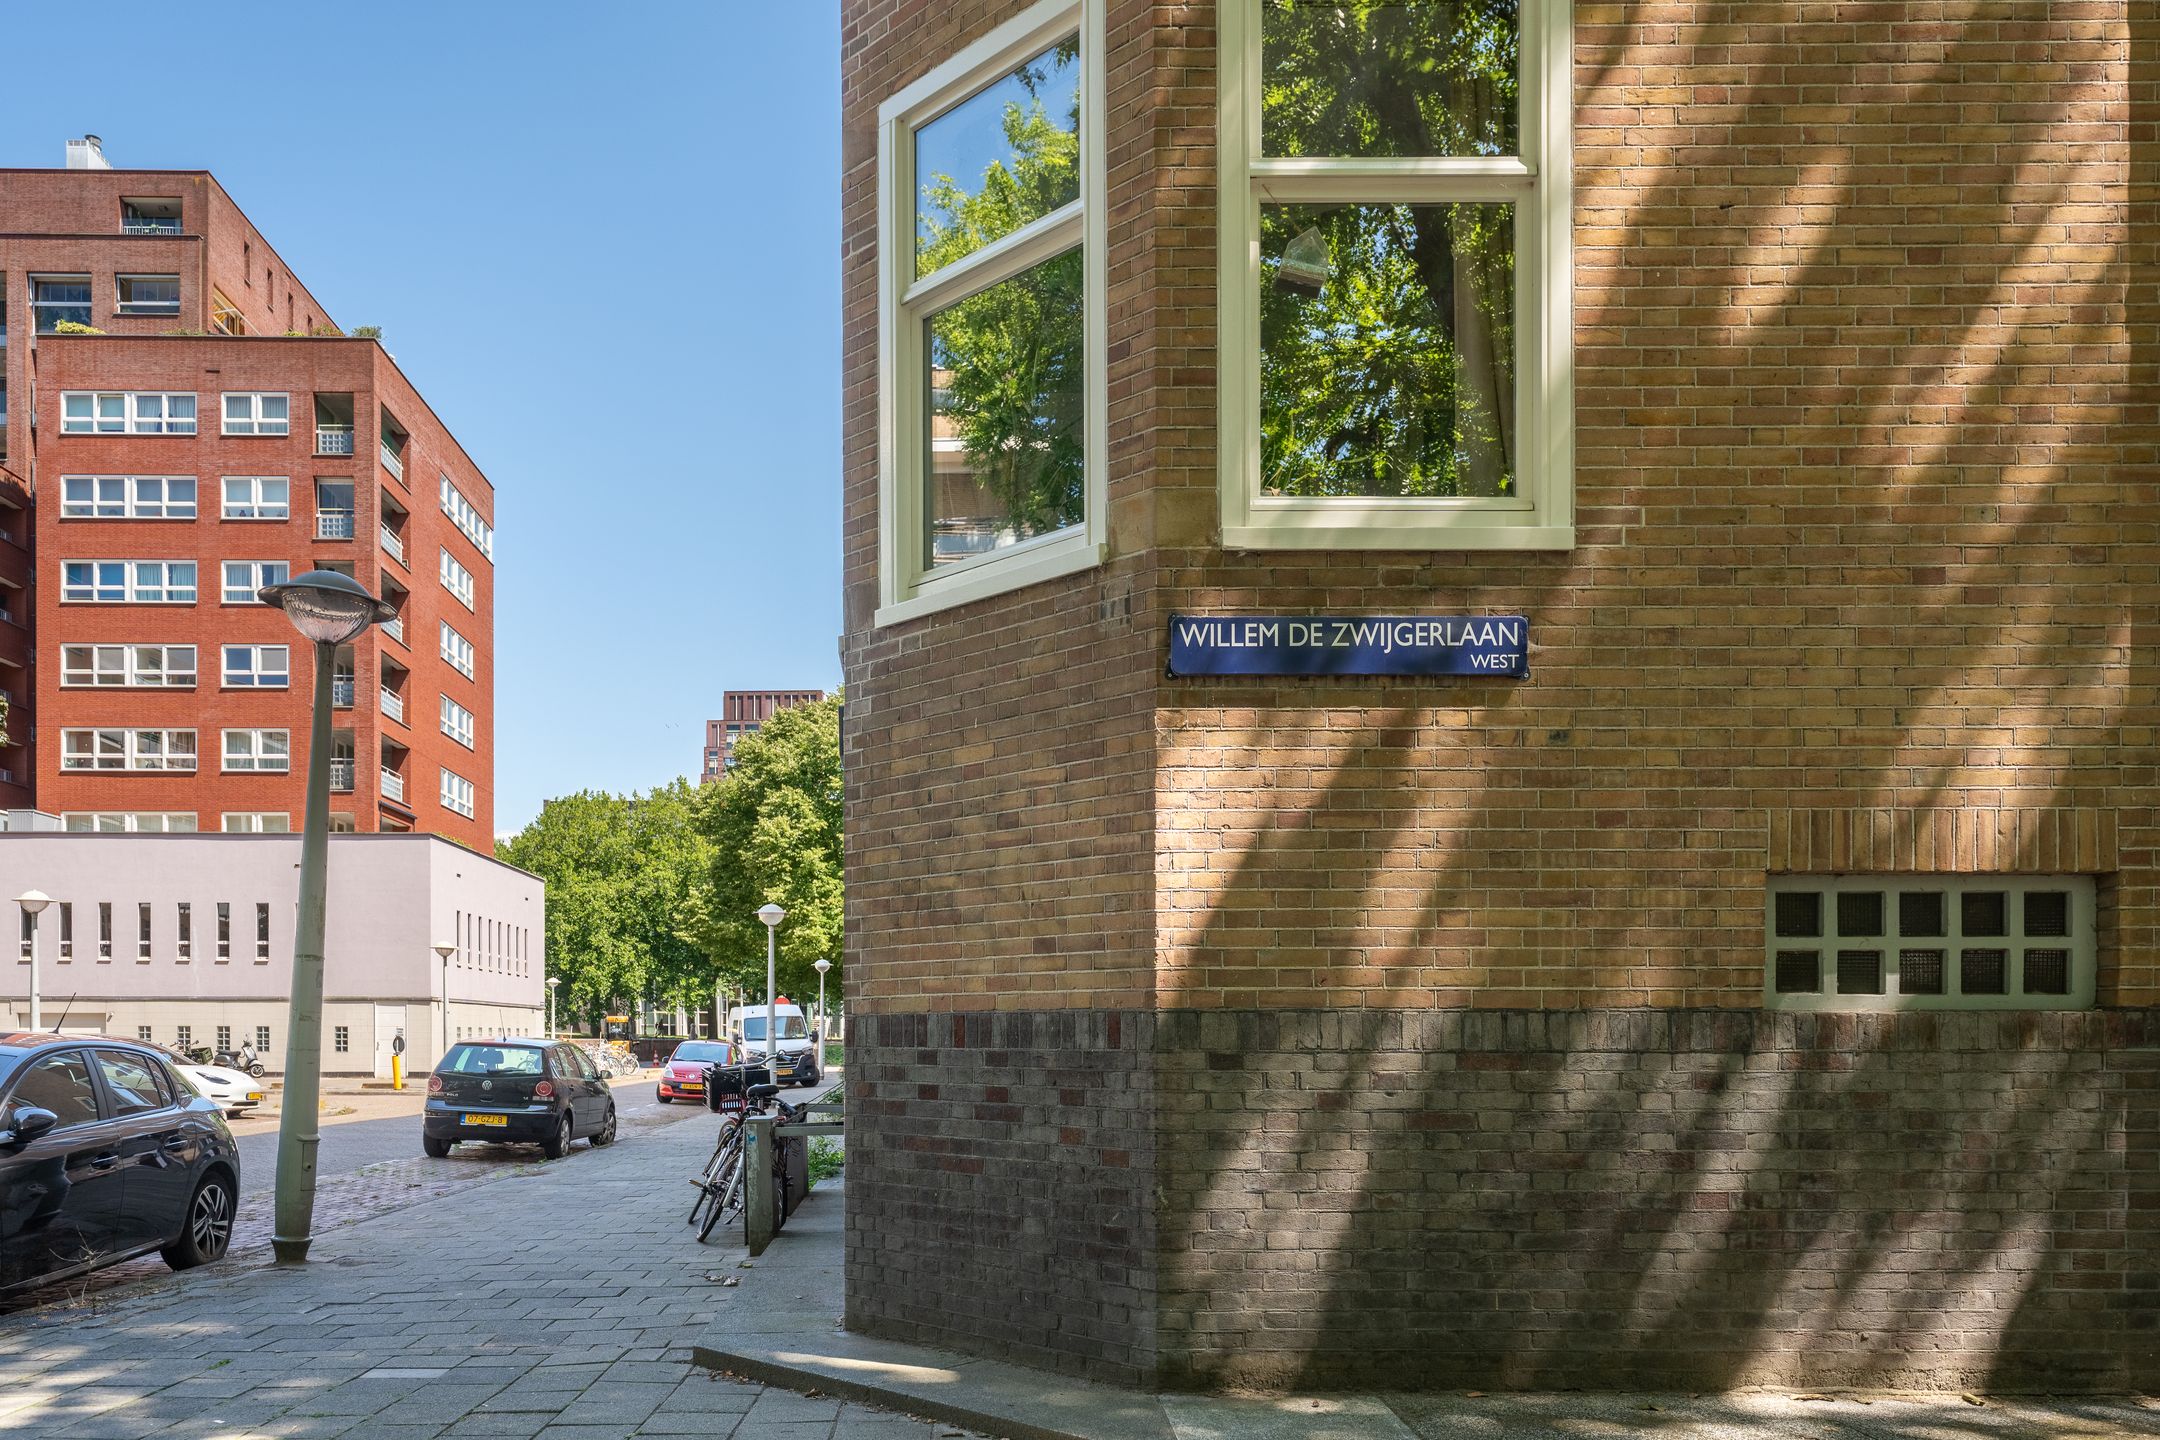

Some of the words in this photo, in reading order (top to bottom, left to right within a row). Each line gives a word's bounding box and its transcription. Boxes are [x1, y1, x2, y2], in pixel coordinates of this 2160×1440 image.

[1179, 623, 1279, 647] WILLEM
[1289, 623, 1323, 647] DE
[1331, 622, 1519, 654] ZWIJGERLAAN
[1470, 654, 1519, 669] WEST
